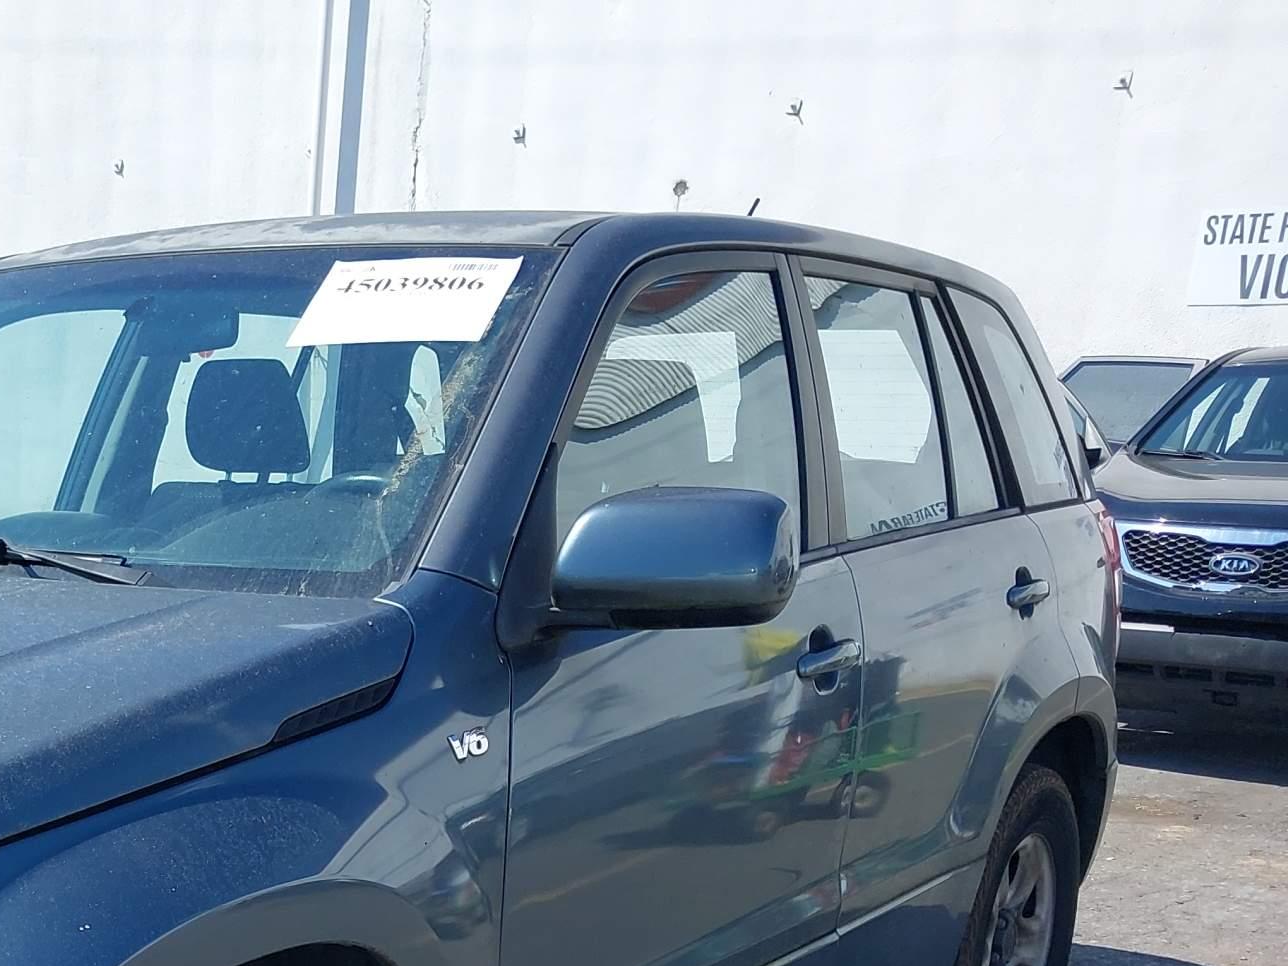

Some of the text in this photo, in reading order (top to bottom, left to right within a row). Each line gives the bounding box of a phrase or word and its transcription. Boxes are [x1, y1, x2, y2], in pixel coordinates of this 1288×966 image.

[1203, 213, 1275, 245] STATE
[336, 276, 485, 294] 45039806
[1220, 558, 1250, 573] KIA
[448, 726, 489, 760] V6
